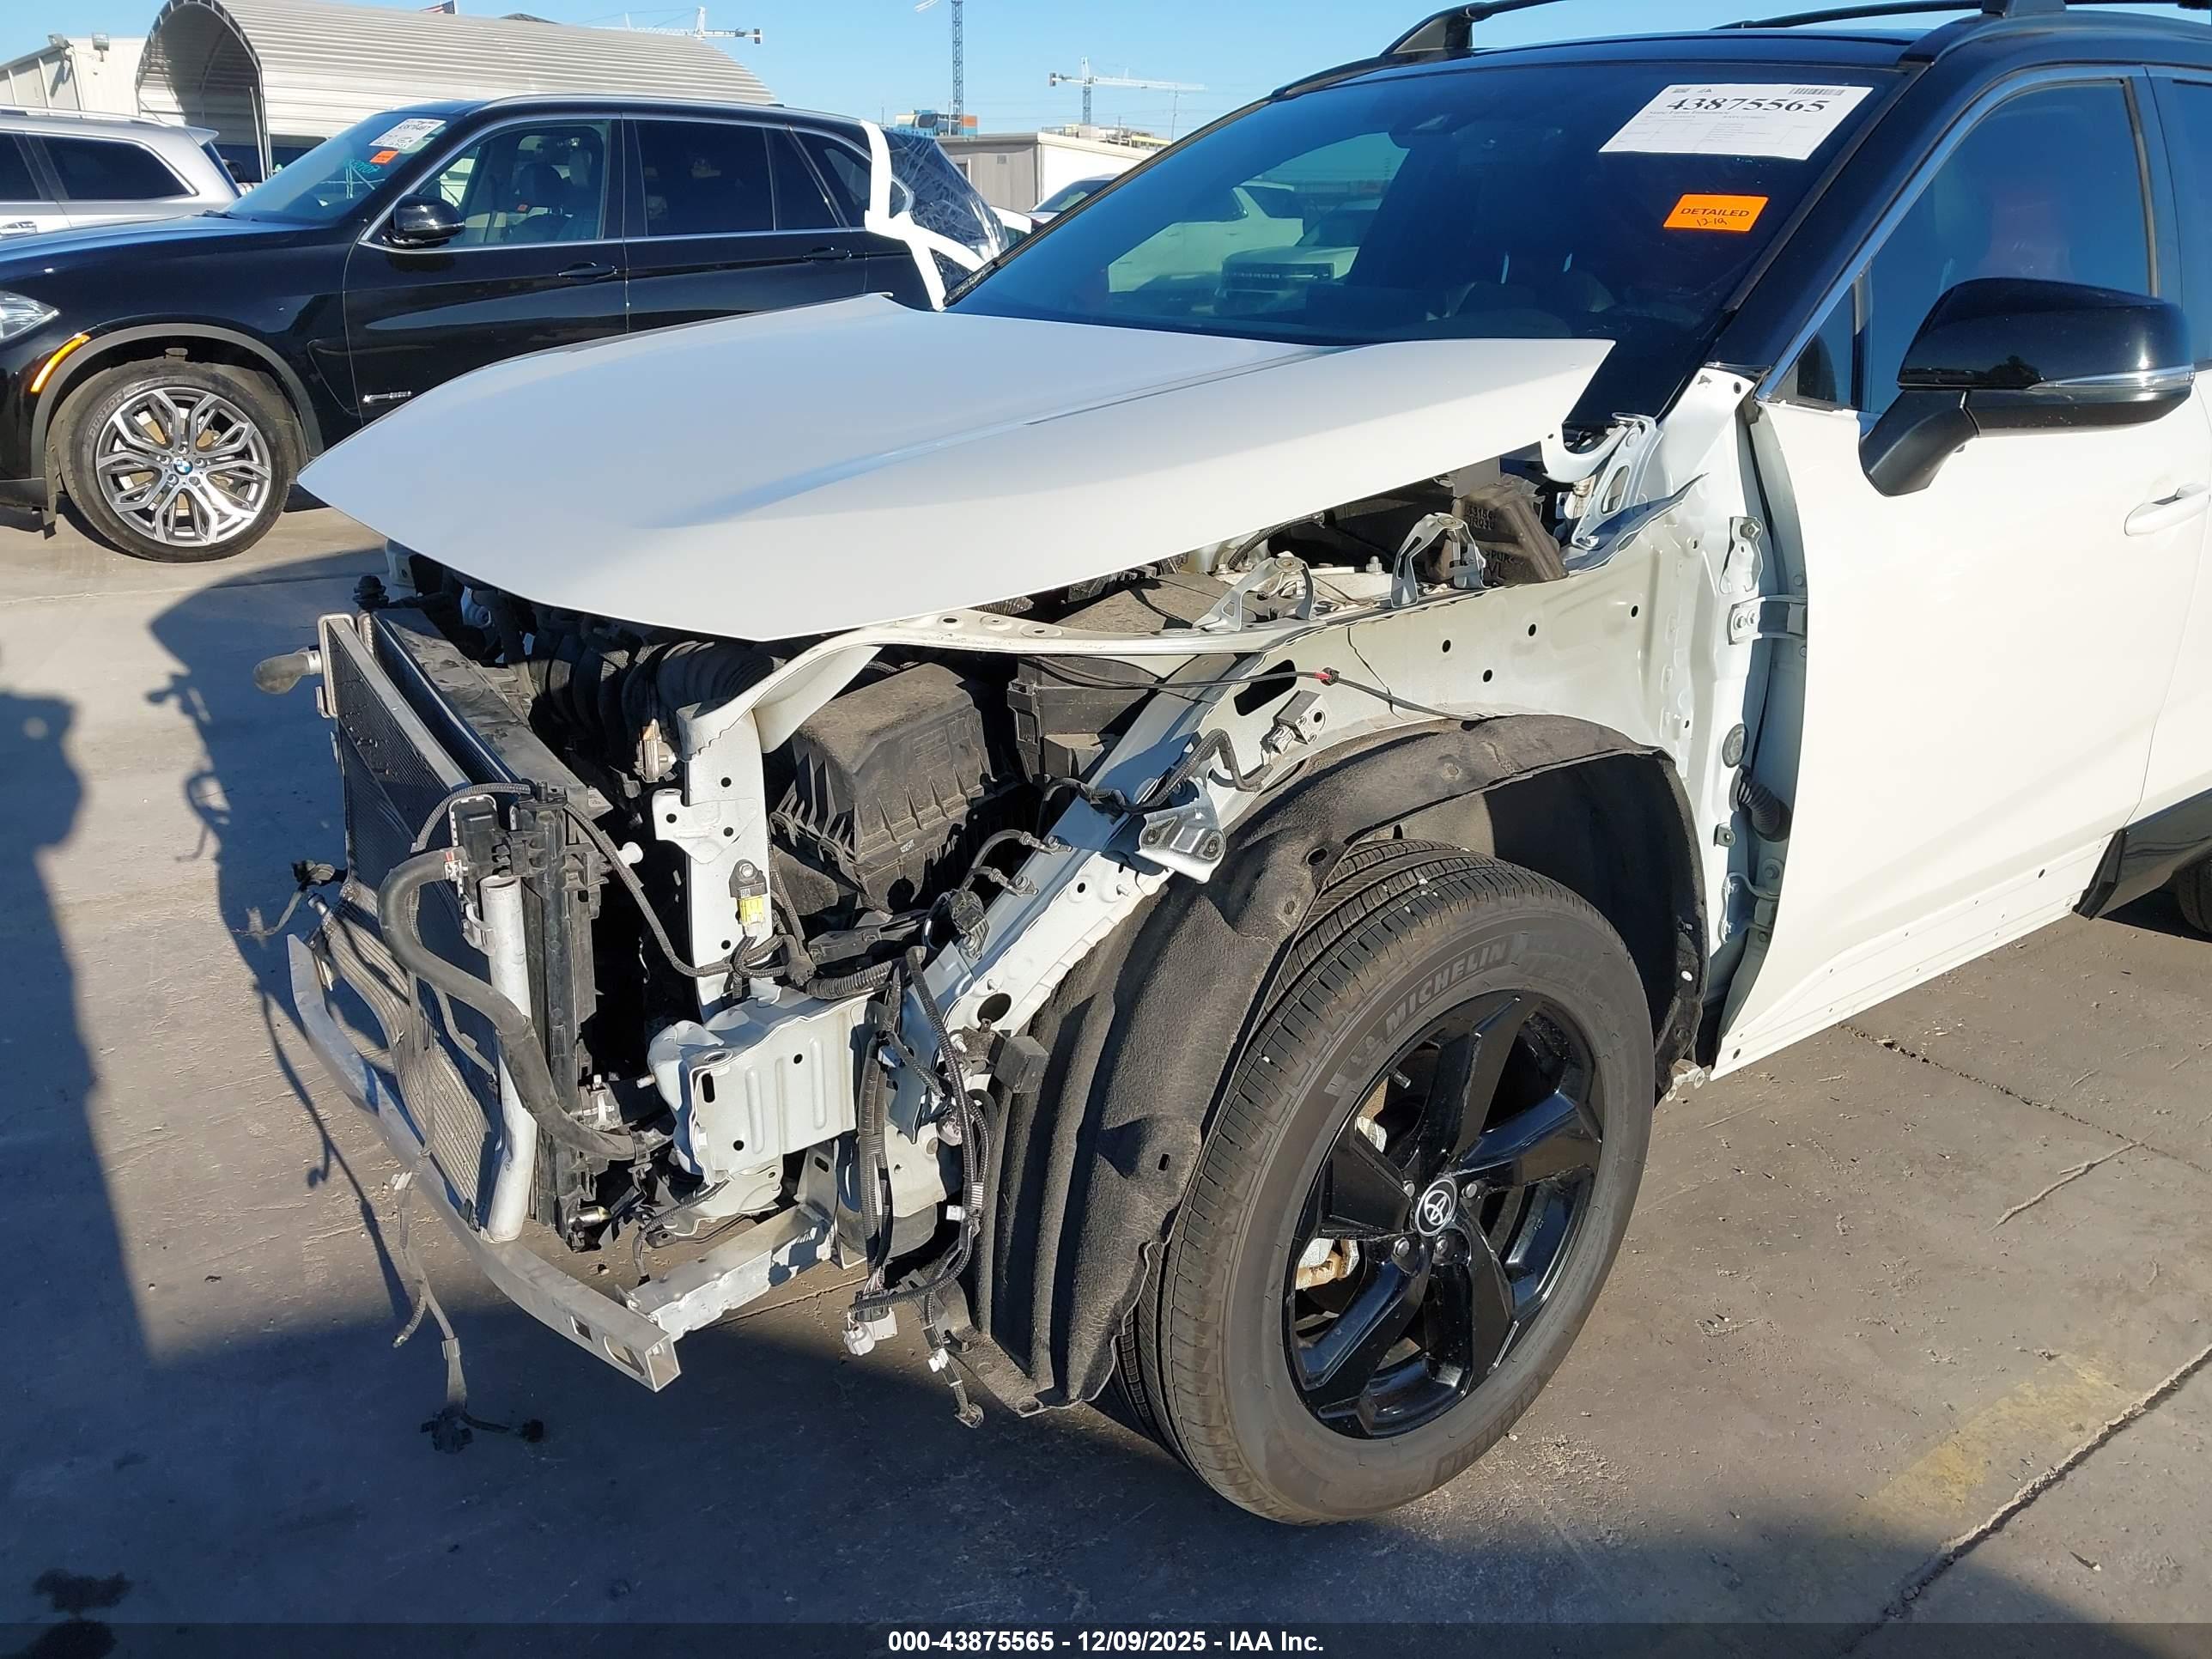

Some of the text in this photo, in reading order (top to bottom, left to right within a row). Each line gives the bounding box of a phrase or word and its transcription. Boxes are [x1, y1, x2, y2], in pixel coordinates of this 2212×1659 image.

[1666, 97, 1831, 112] 43875565
[1680, 207, 1750, 217] DETAILED
[1385, 942, 1507, 1037] MICHELIN
